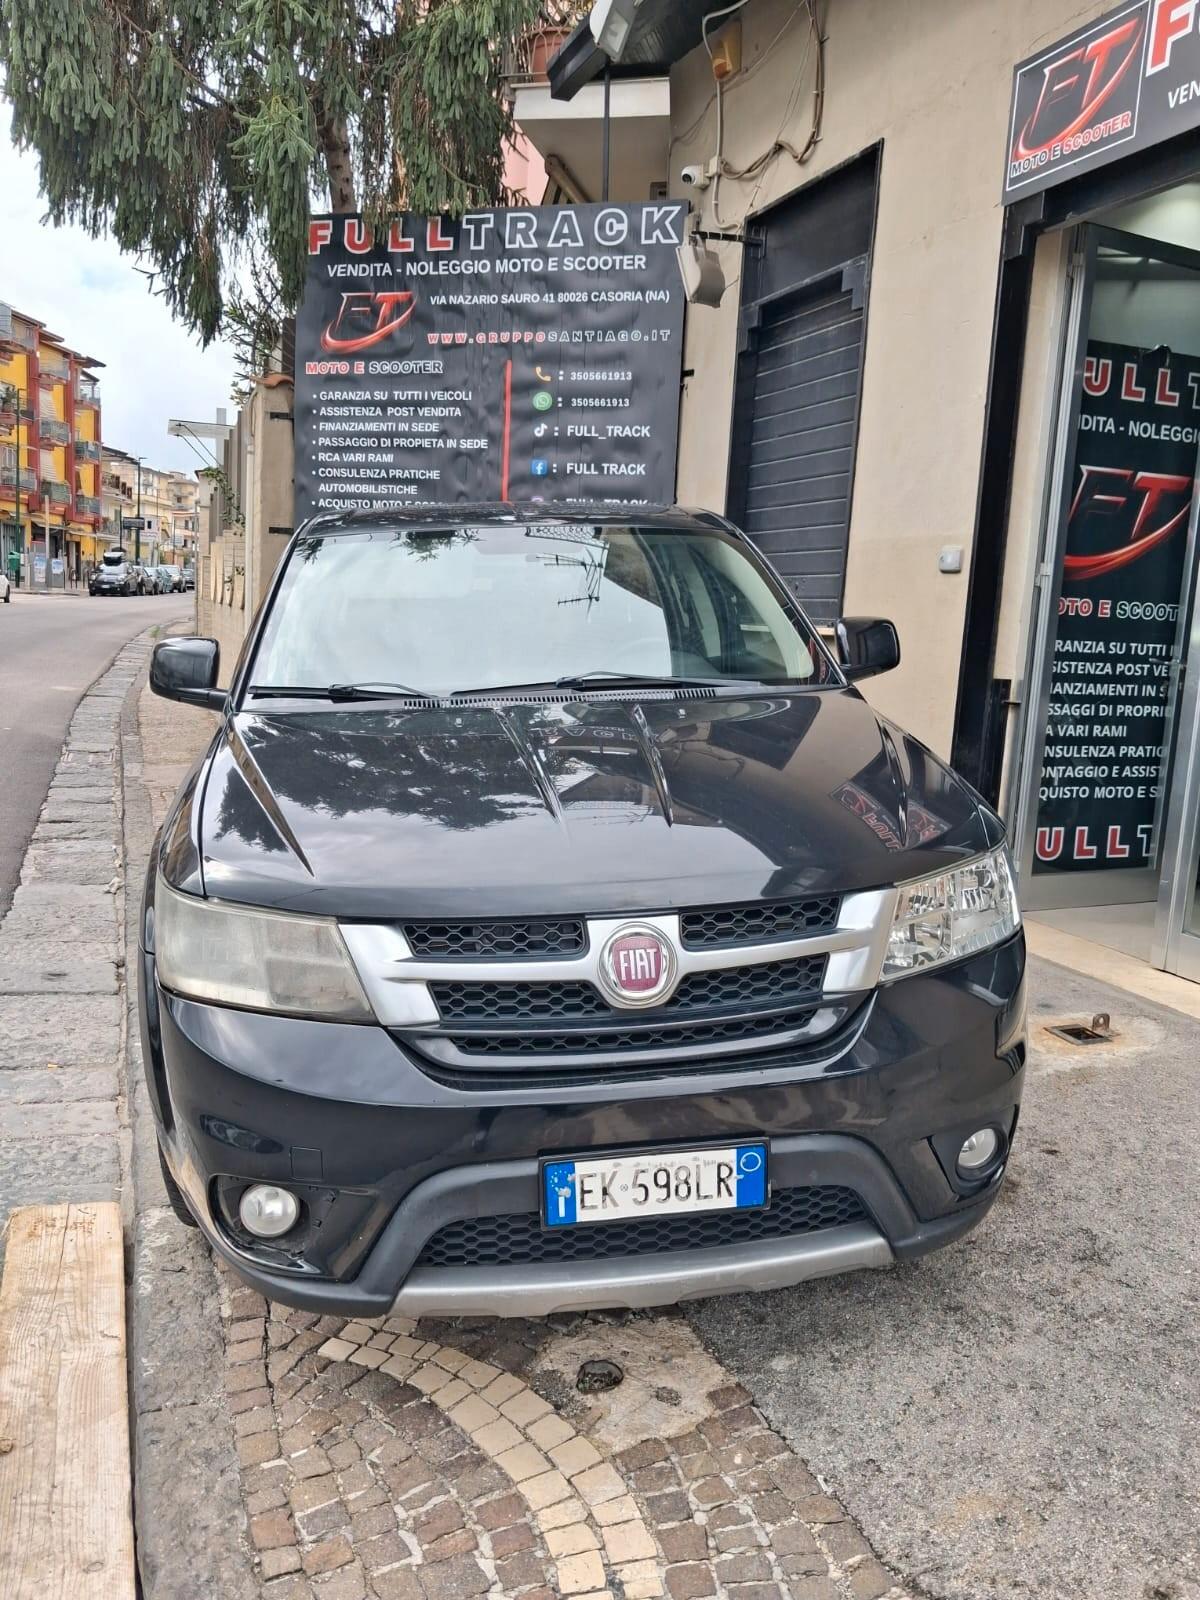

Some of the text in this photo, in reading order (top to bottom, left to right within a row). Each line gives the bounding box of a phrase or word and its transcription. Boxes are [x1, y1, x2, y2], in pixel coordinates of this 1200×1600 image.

[1010, 111, 1132, 178] MOTO E SCOOTER
[327, 262, 392, 277] VENDITA
[406, 259, 491, 276] NOLEGGIO
[495, 257, 544, 273] MOTO
[547, 257, 559, 271] E
[563, 255, 647, 271] SCOOTER
[430, 290, 670, 305] VIA NAZARIO SAURO 41 80026 CASORIA (NA)
[427, 329, 671, 345] WWW.GRUPPOSANTIAGO.IT
[305, 360, 444, 375] MOTO E SCOOTER
[570, 371, 632, 381] 3505661913
[319, 390, 472, 401] GARANZIA SU TUTTI I VEICOLI
[571, 398, 630, 407] 3505661913
[319, 406, 462, 417] ASSISTENZA POST VENDITA
[319, 422, 440, 432] FINANZIAMENTI IN SEDE
[567, 425, 651, 440] FULL_TRACK
[1078, 414, 1115, 434] DITA
[1128, 420, 1200, 444] NOLEGGI
[318, 437, 489, 449] PASSAGGIO DI PROPIETA IN SEDE
[318, 452, 394, 463] RCA VARI RAMI
[318, 467, 441, 479] CONSULENZA PRATICHE
[566, 462, 598, 475] FULL
[602, 463, 646, 476] TRACK
[318, 483, 418, 495] AUTOMOBILISTICHE
[318, 498, 371, 509] ACQUISTO
[1097, 599, 1112, 618] E
[1055, 639, 1106, 655] RANZIA
[1108, 642, 1126, 655] SU
[1129, 643, 1167, 657] TUTTI
[1115, 662, 1150, 676] POST
[1141, 685, 1157, 697] IN
[1098, 704, 1113, 717] DI
[1057, 724, 1089, 737] VARI
[1093, 725, 1127, 738] RAMI
[1044, 745, 1116, 758] NSULENZA
[1112, 766, 1119, 778] E
[1039, 786, 1090, 800] QUISTO
[1094, 786, 1134, 799] MOTO
[1137, 786, 1146, 798] E
[619, 948, 658, 981] FIAT
